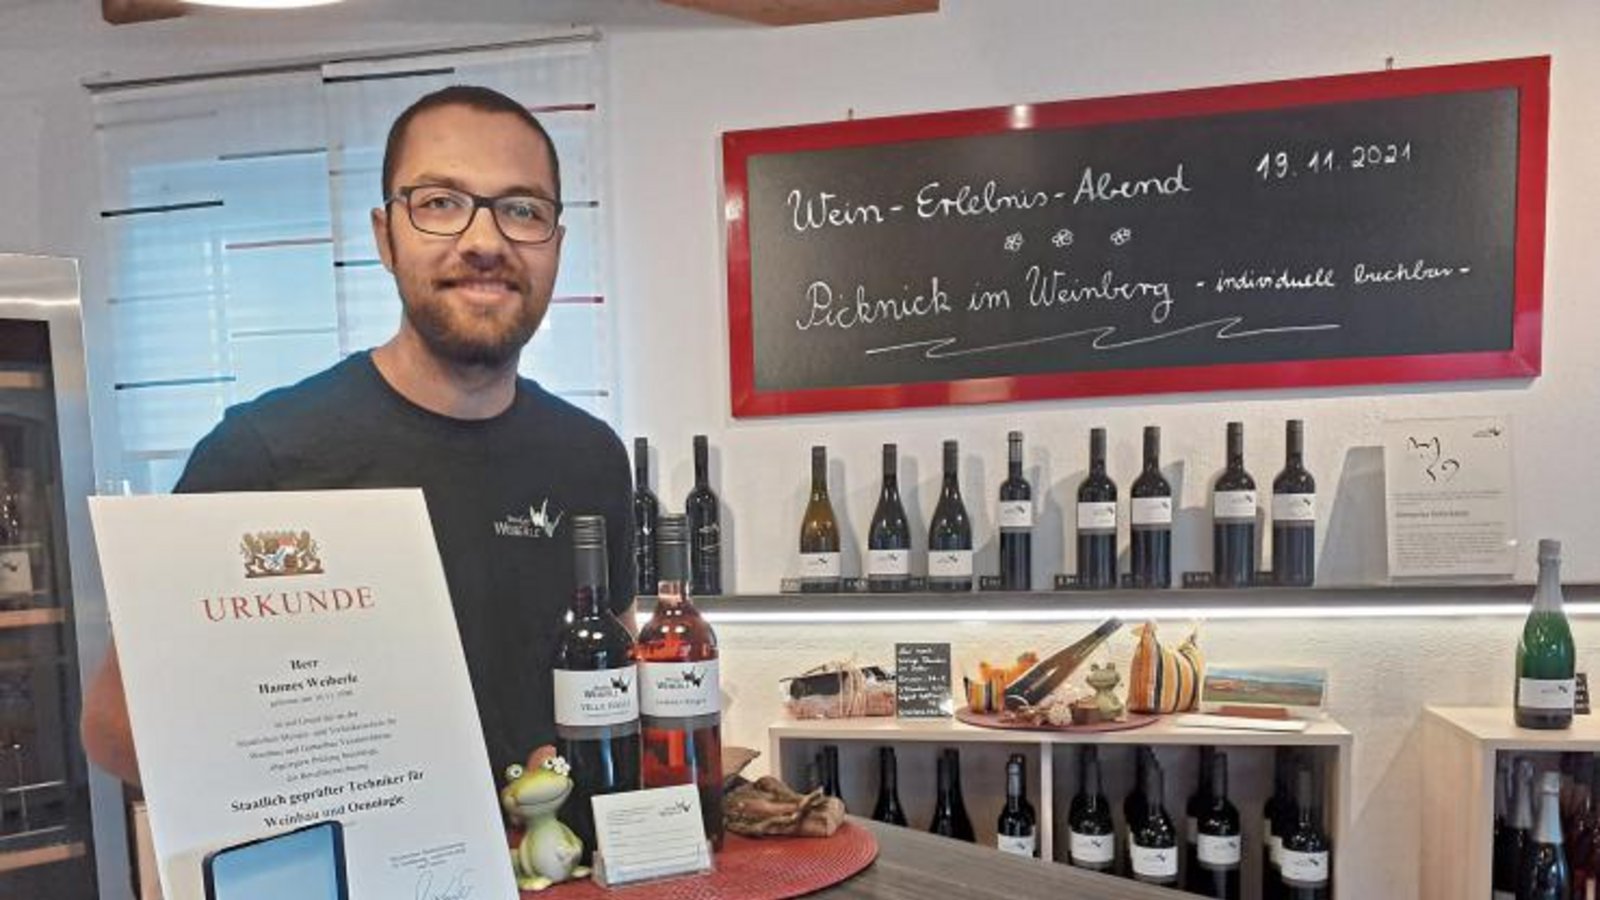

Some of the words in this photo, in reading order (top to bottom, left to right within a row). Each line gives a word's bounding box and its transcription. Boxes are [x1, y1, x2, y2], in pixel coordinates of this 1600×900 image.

[1072, 163, 1193, 205] Abend
[796, 276, 952, 331] Picknick
[967, 281, 1010, 310] im
[1025, 265, 1175, 324] Weinberg
[201, 586, 376, 622] URKUNDE
[290, 660, 319, 671] Herr
[231, 793, 287, 813] Staatlich
[348, 771, 405, 793] Techniker
[407, 769, 425, 782] für
[264, 810, 320, 829] Weinbau
[322, 804, 346, 819] und
